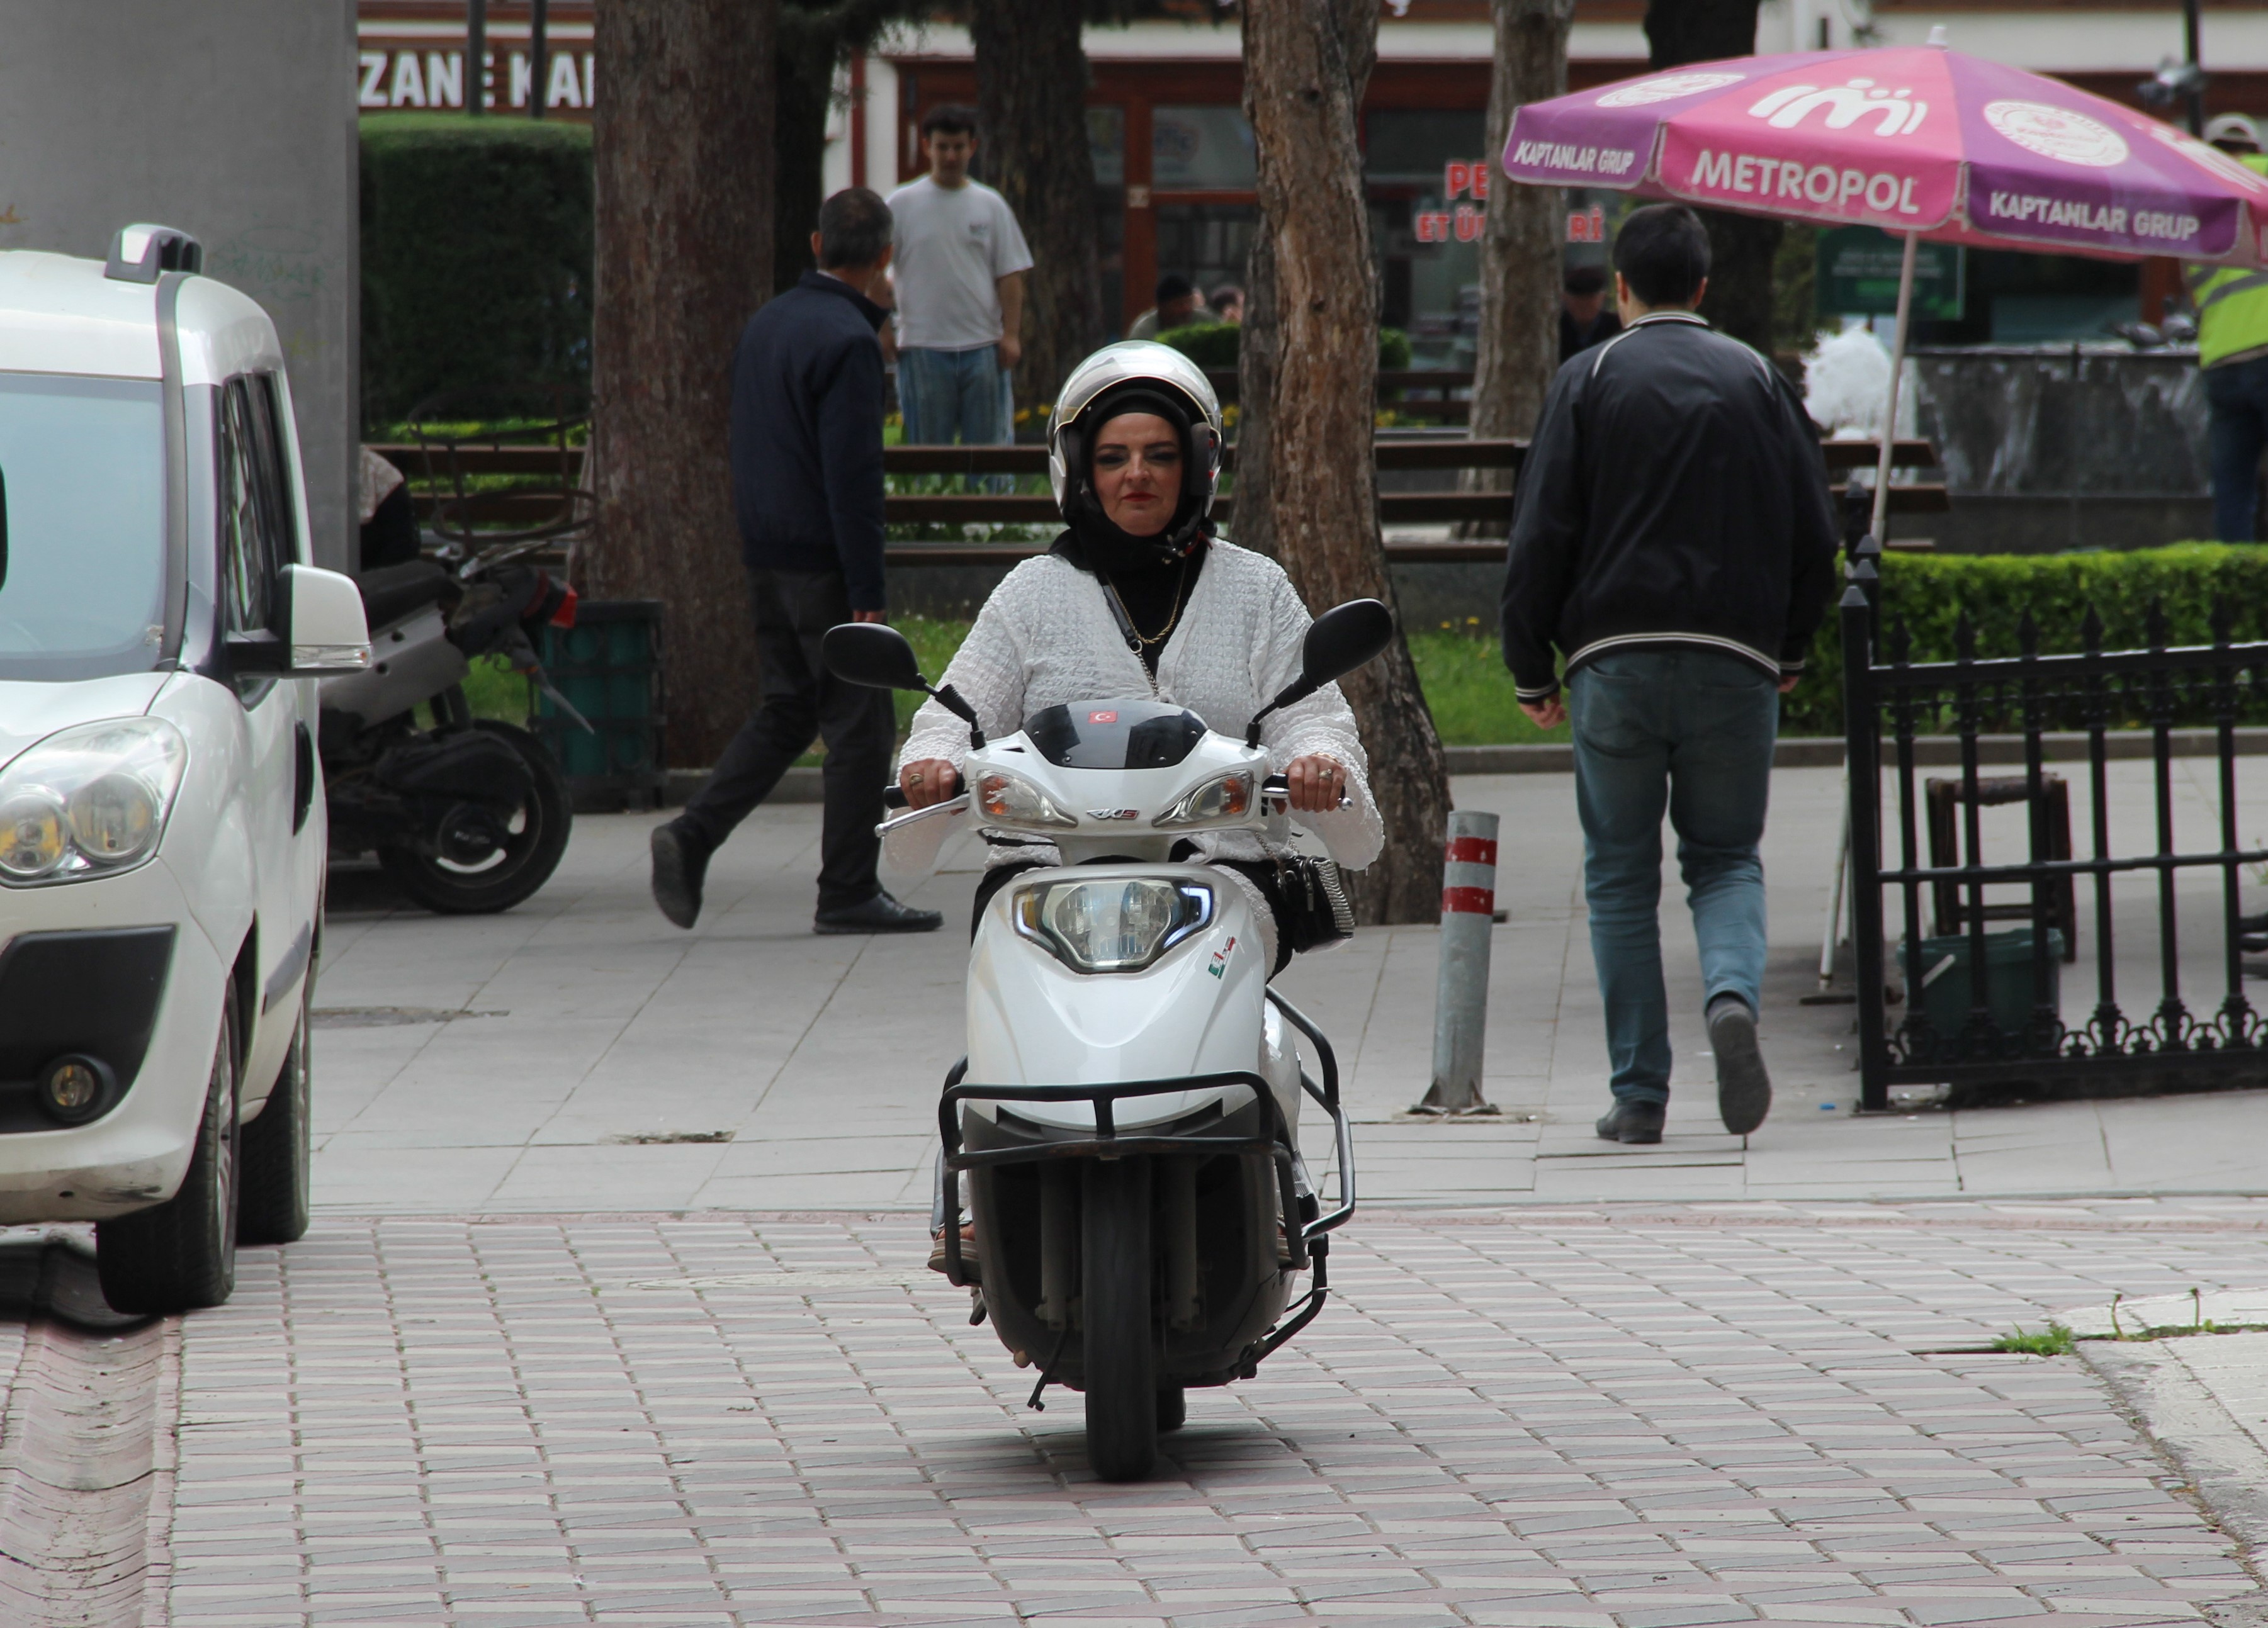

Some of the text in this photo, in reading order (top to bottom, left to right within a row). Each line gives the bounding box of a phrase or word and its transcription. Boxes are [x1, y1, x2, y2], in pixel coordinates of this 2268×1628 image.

[1513, 140, 1635, 174] KAPTANLAR GRUP
[1691, 149, 1920, 215] METROPOL
[1989, 191, 2201, 241] KAPTANLAR GRUP
